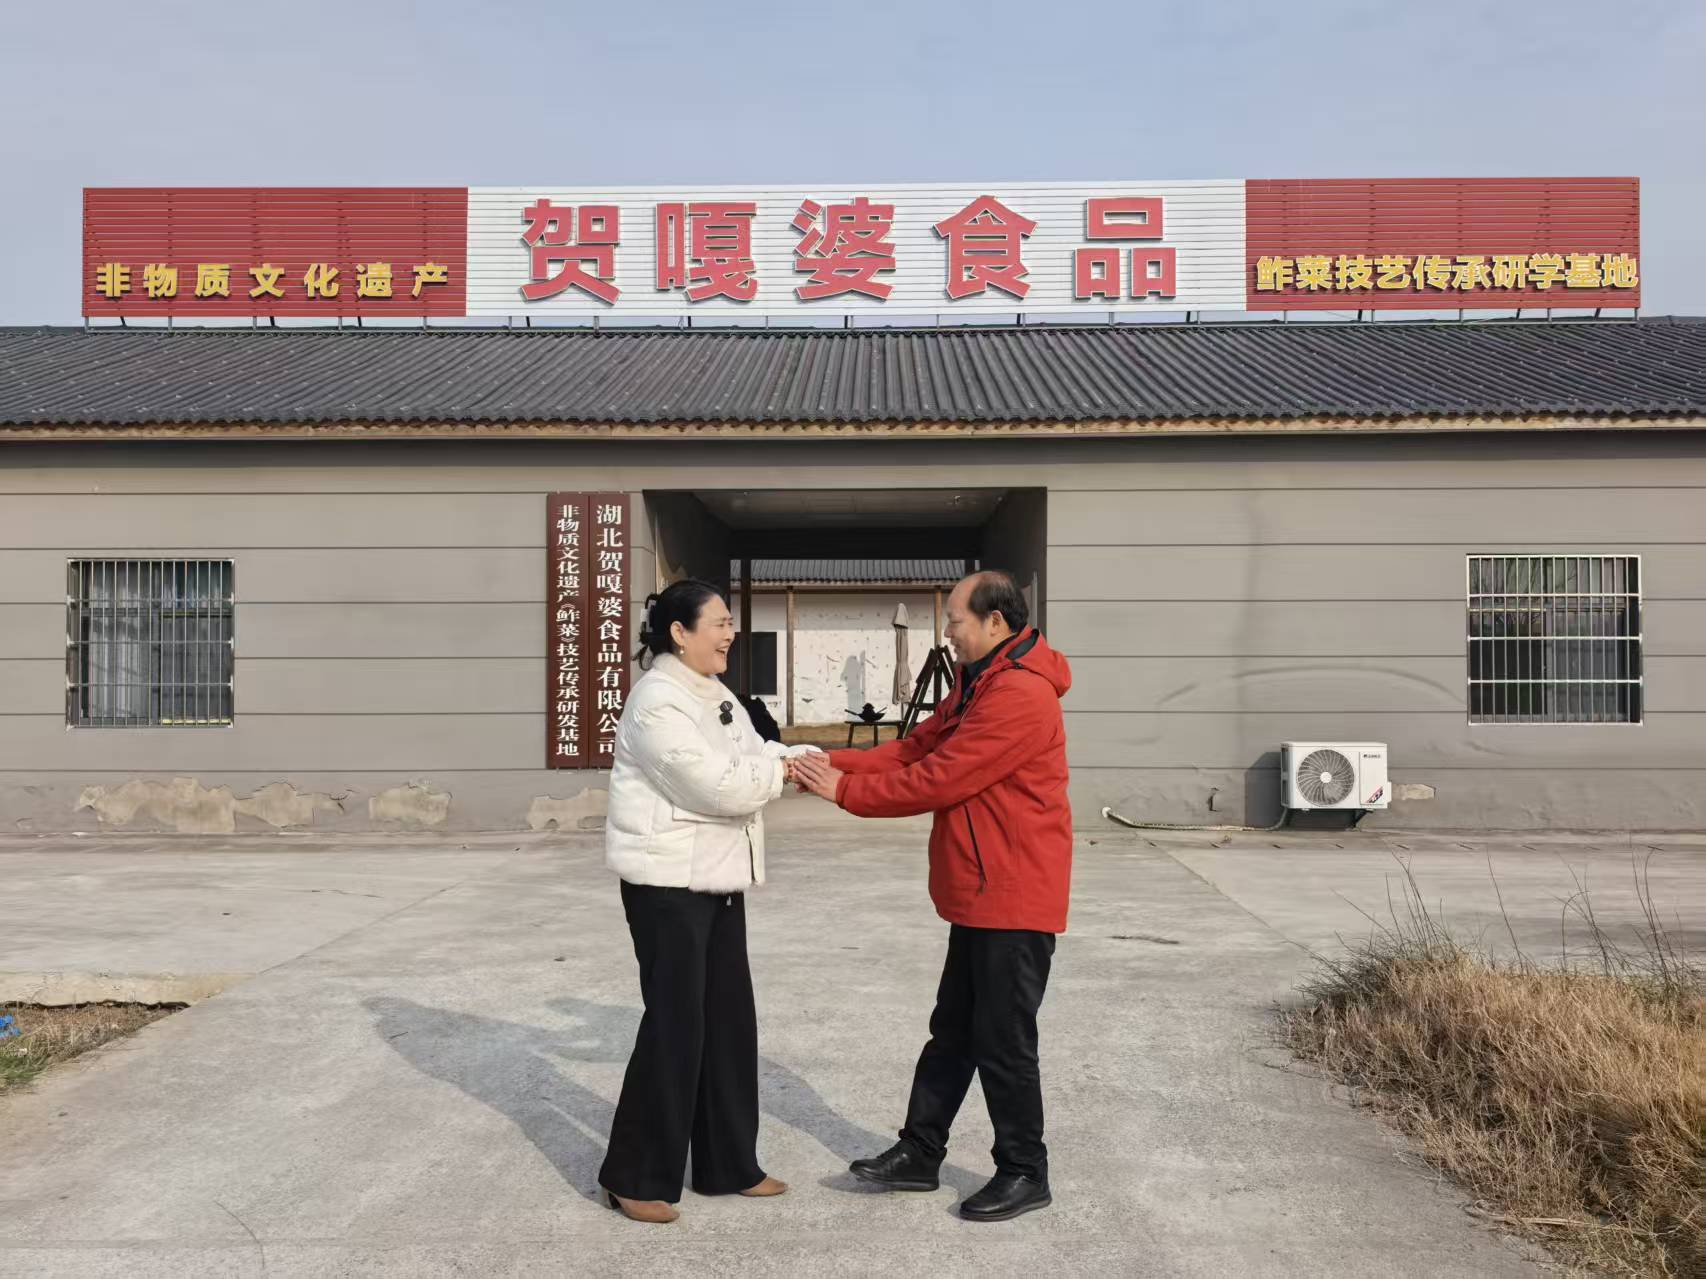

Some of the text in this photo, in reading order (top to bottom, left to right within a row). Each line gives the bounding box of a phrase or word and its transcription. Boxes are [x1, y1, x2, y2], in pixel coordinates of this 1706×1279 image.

[96, 263, 449, 298] 非物质文化遗产
[521, 195, 1177, 305] 贺嘎婆食品
[1256, 252, 1639, 290] 鲊菜技艺传承研学基地
[596, 504, 624, 756] 湖北贺嘎婆食品有限公司
